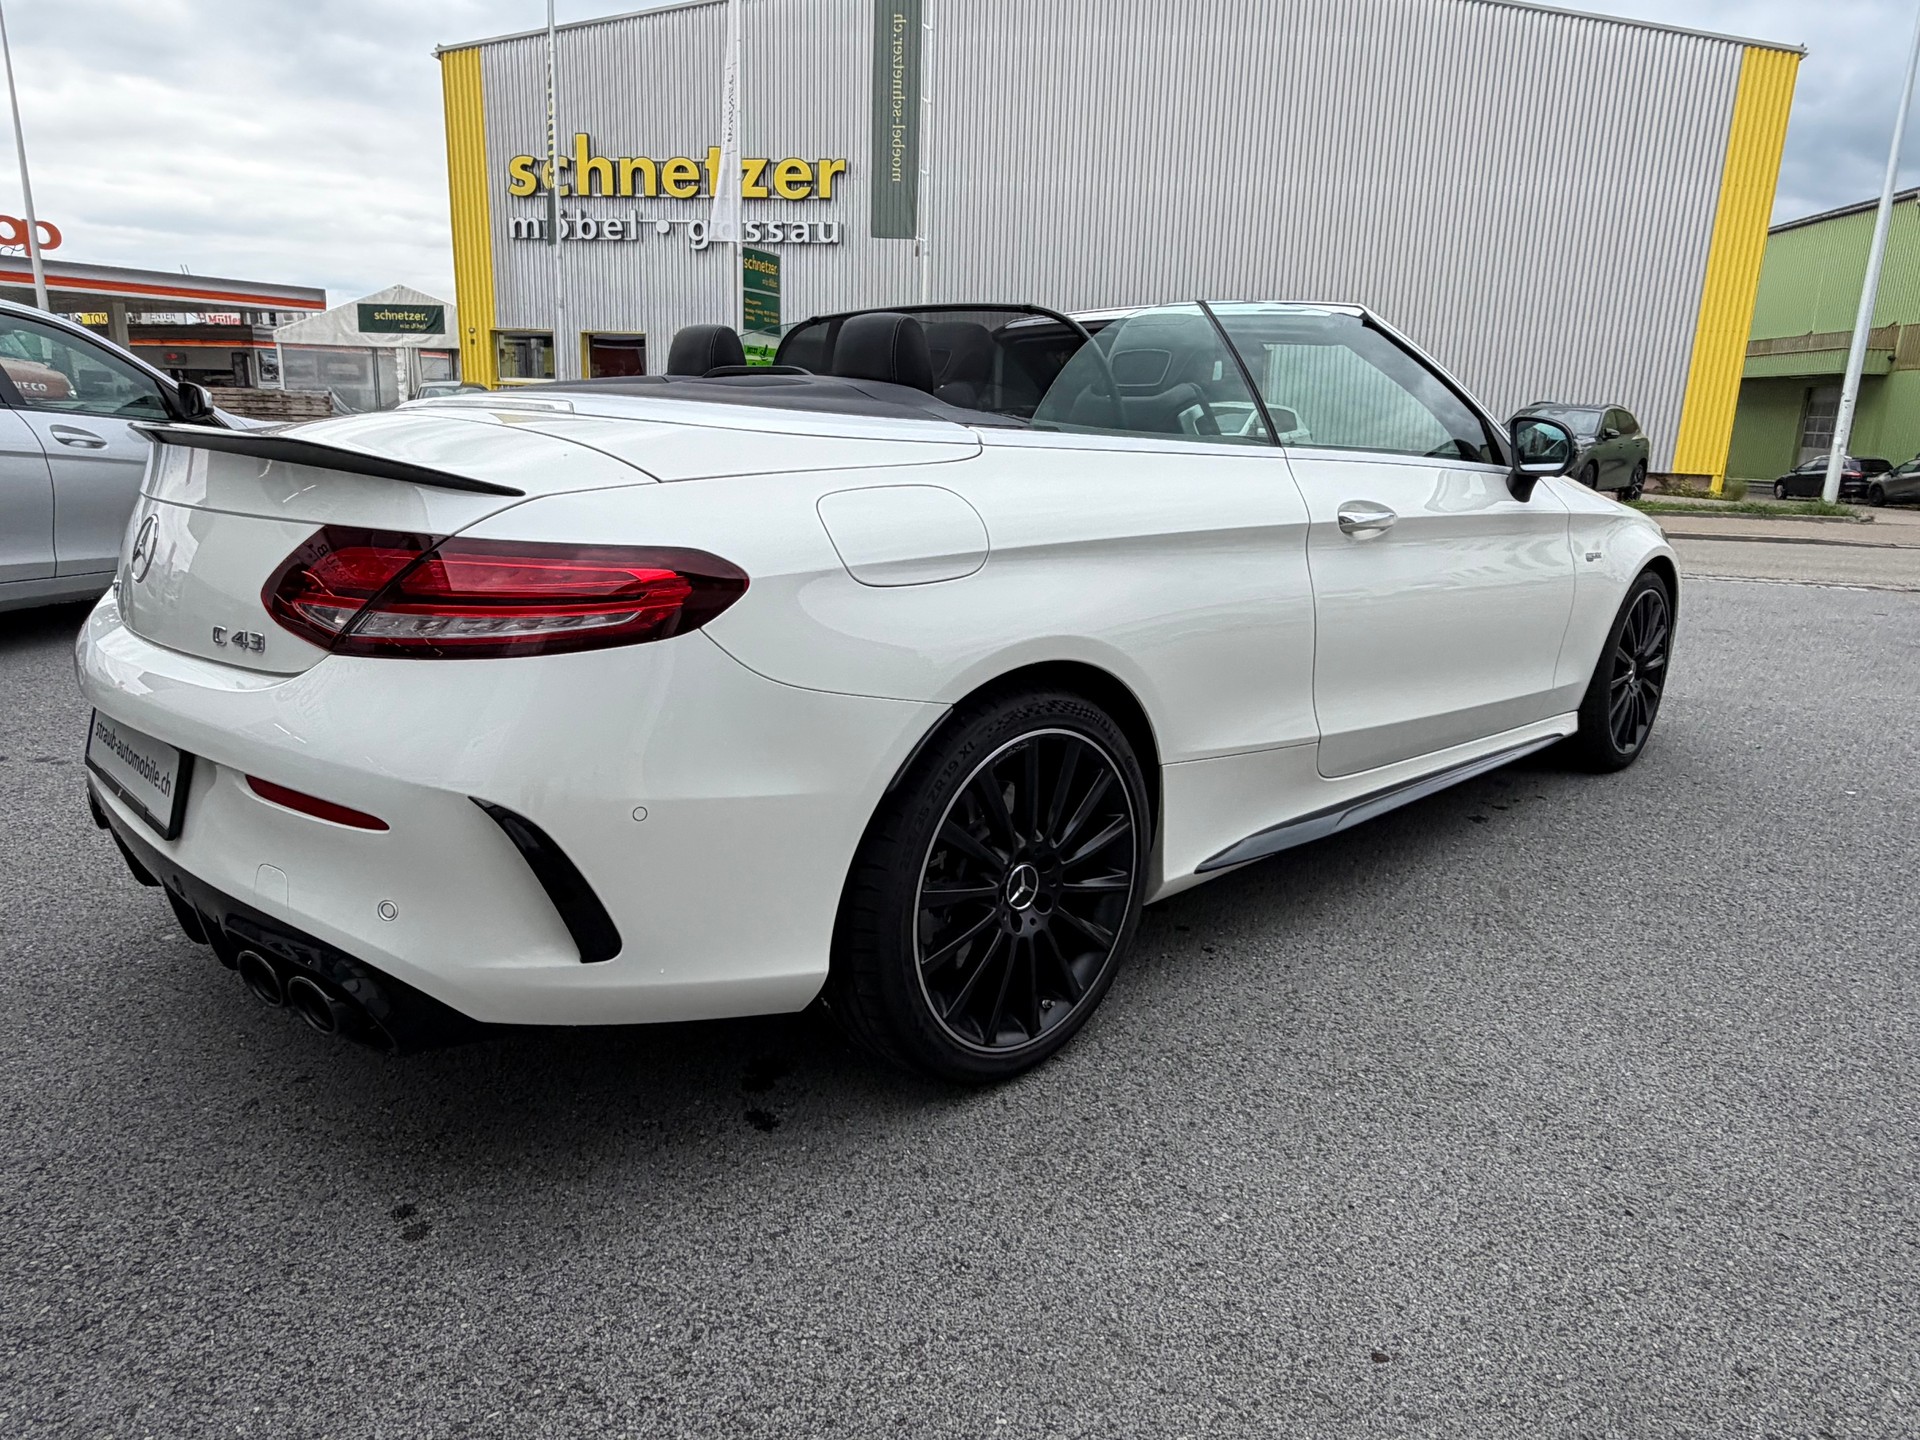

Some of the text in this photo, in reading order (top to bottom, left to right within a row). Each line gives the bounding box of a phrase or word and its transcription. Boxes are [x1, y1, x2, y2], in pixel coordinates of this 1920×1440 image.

[688, 219, 841, 250] gssau
[374, 308, 428, 321] schnetzer.
[213, 626, 266, 654] C 43
[95, 721, 171, 798] straub-automobile.ch
